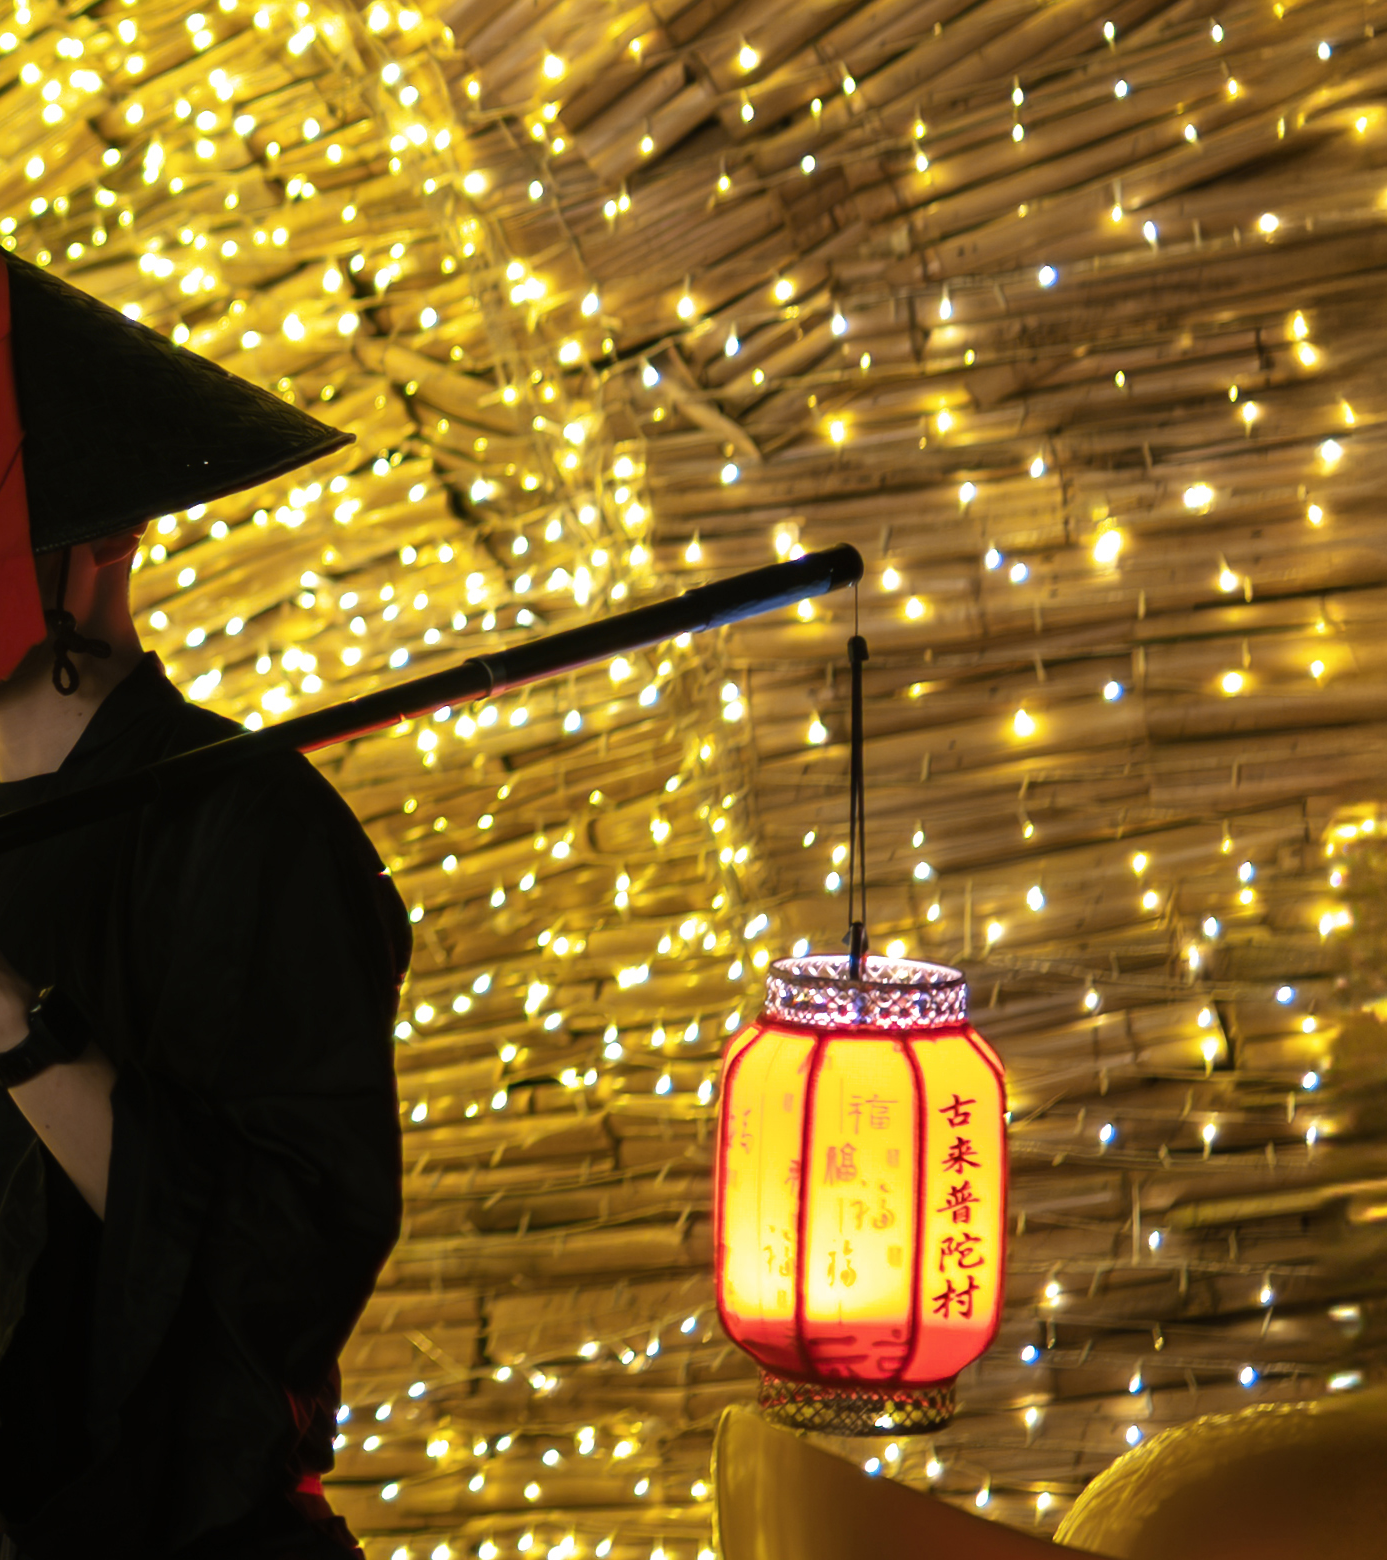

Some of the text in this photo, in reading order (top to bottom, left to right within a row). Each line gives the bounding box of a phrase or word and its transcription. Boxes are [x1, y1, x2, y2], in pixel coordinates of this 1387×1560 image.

[932, 1093, 985, 1321] 古来普陀村
